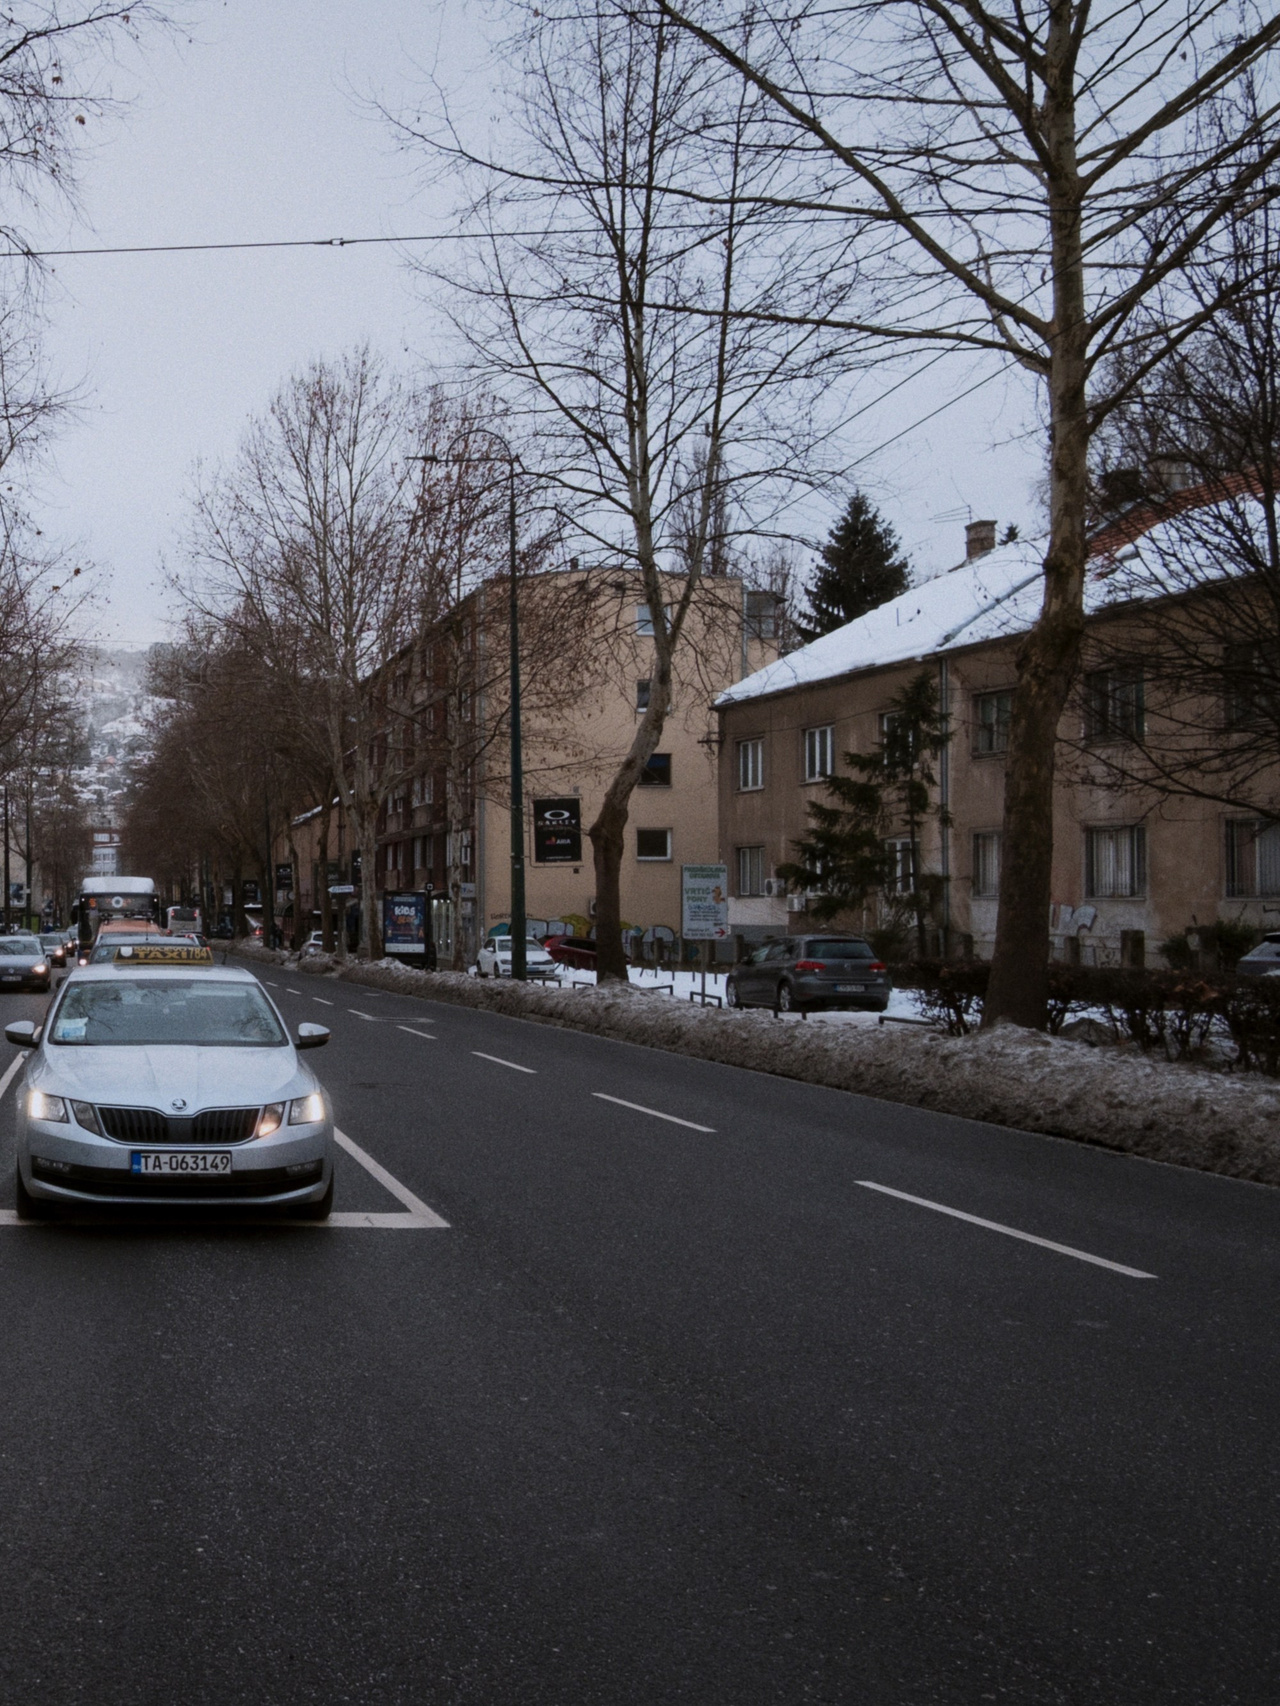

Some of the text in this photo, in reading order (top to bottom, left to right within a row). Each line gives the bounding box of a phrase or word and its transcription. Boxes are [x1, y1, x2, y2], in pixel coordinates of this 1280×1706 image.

[134, 947, 208, 959] TAXI 784
[141, 1155, 230, 1171] TA-063149
